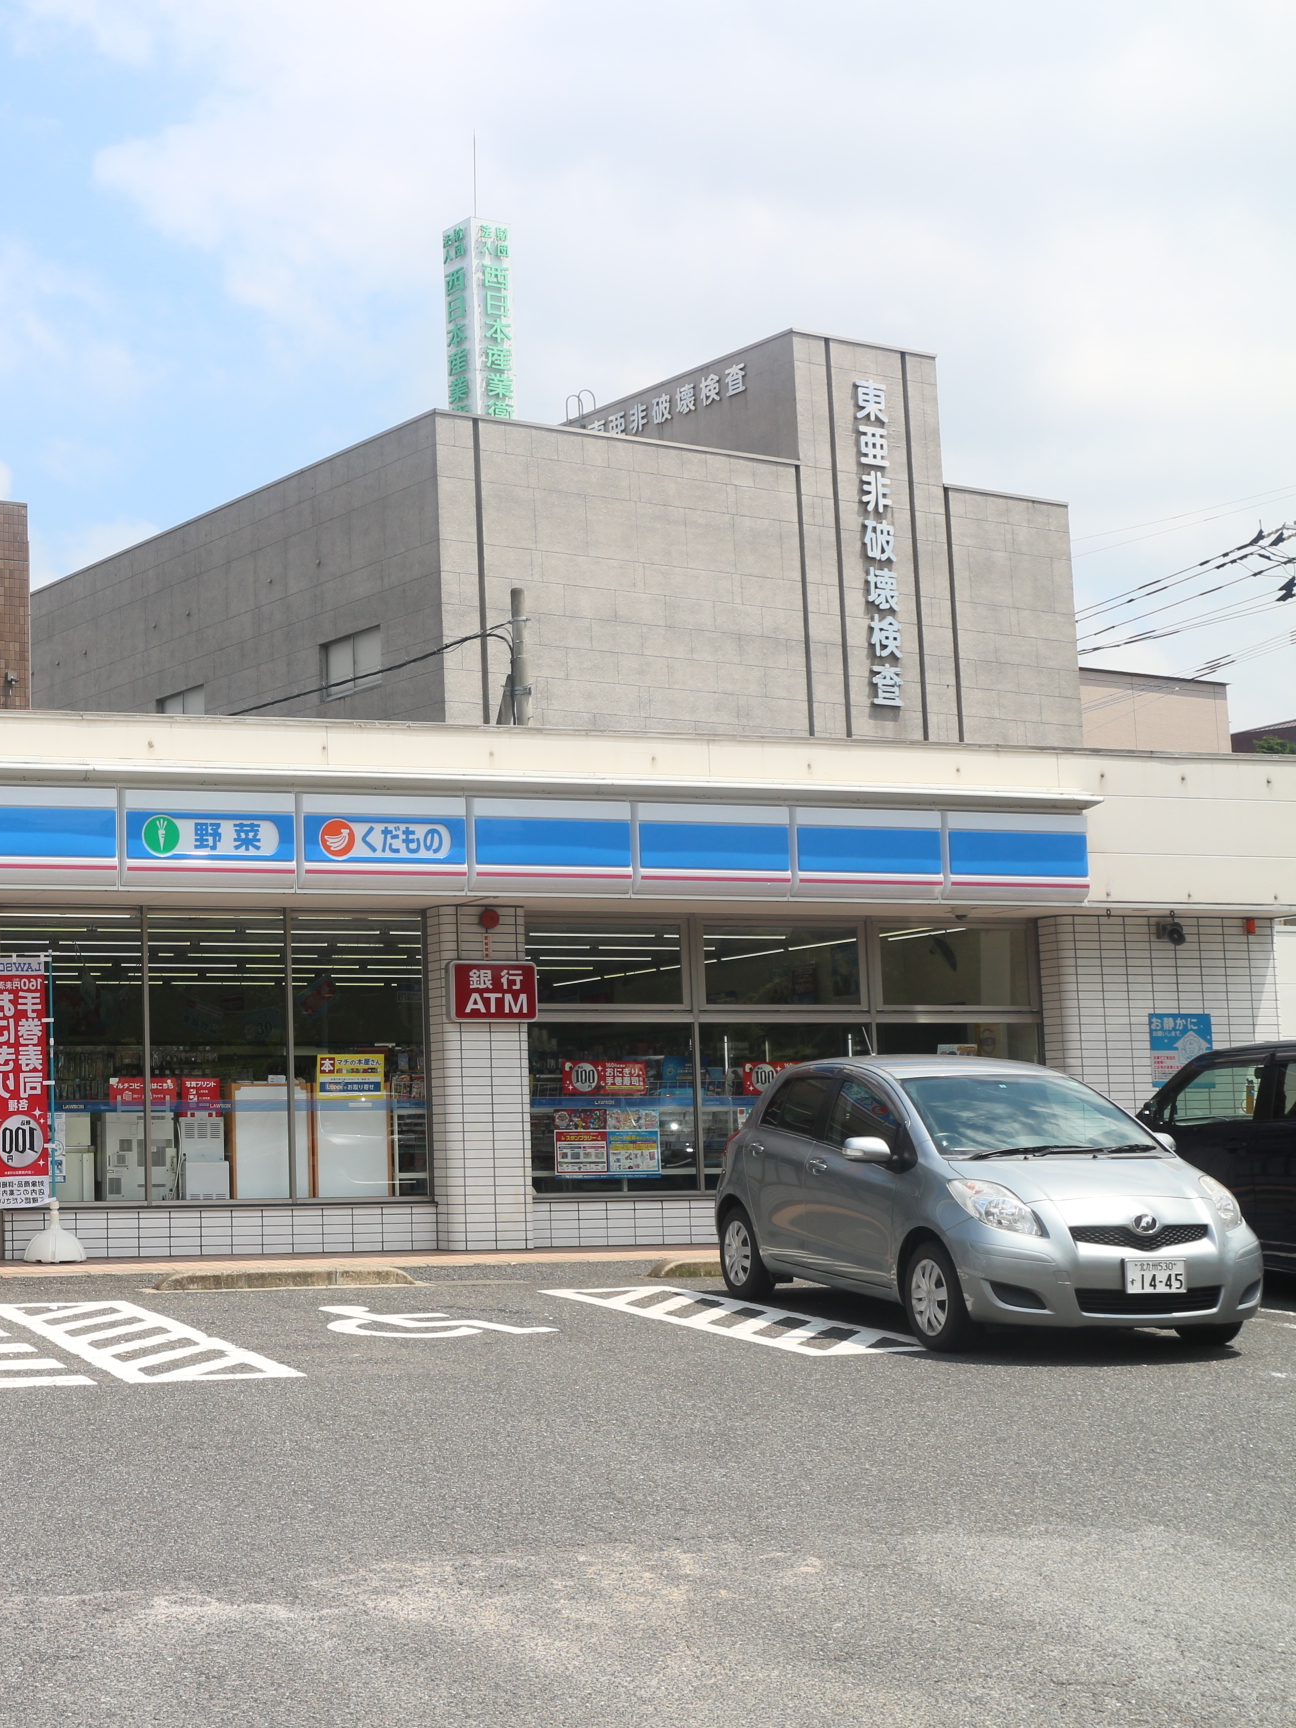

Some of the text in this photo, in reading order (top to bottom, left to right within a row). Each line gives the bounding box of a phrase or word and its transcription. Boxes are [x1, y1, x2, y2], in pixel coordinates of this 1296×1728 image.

[854, 380, 904, 707] 東亜非破壊検査
[193, 822, 261, 851] 野菜
[361, 825, 443, 854] くだもの
[469, 969, 524, 989] 銀行
[465, 993, 528, 1014] ATM
[1150, 1017, 1199, 1030] お静かに
[321, 1058, 334, 1073] 本
[336, 1058, 382, 1066] マチの本屋さん
[113, 1081, 175, 1089] マルチコピーはこちら
[574, 1068, 596, 1085] 100
[1139, 1262, 1174, 1271] 北九州530
[1141, 1273, 1184, 1290] 14-45
